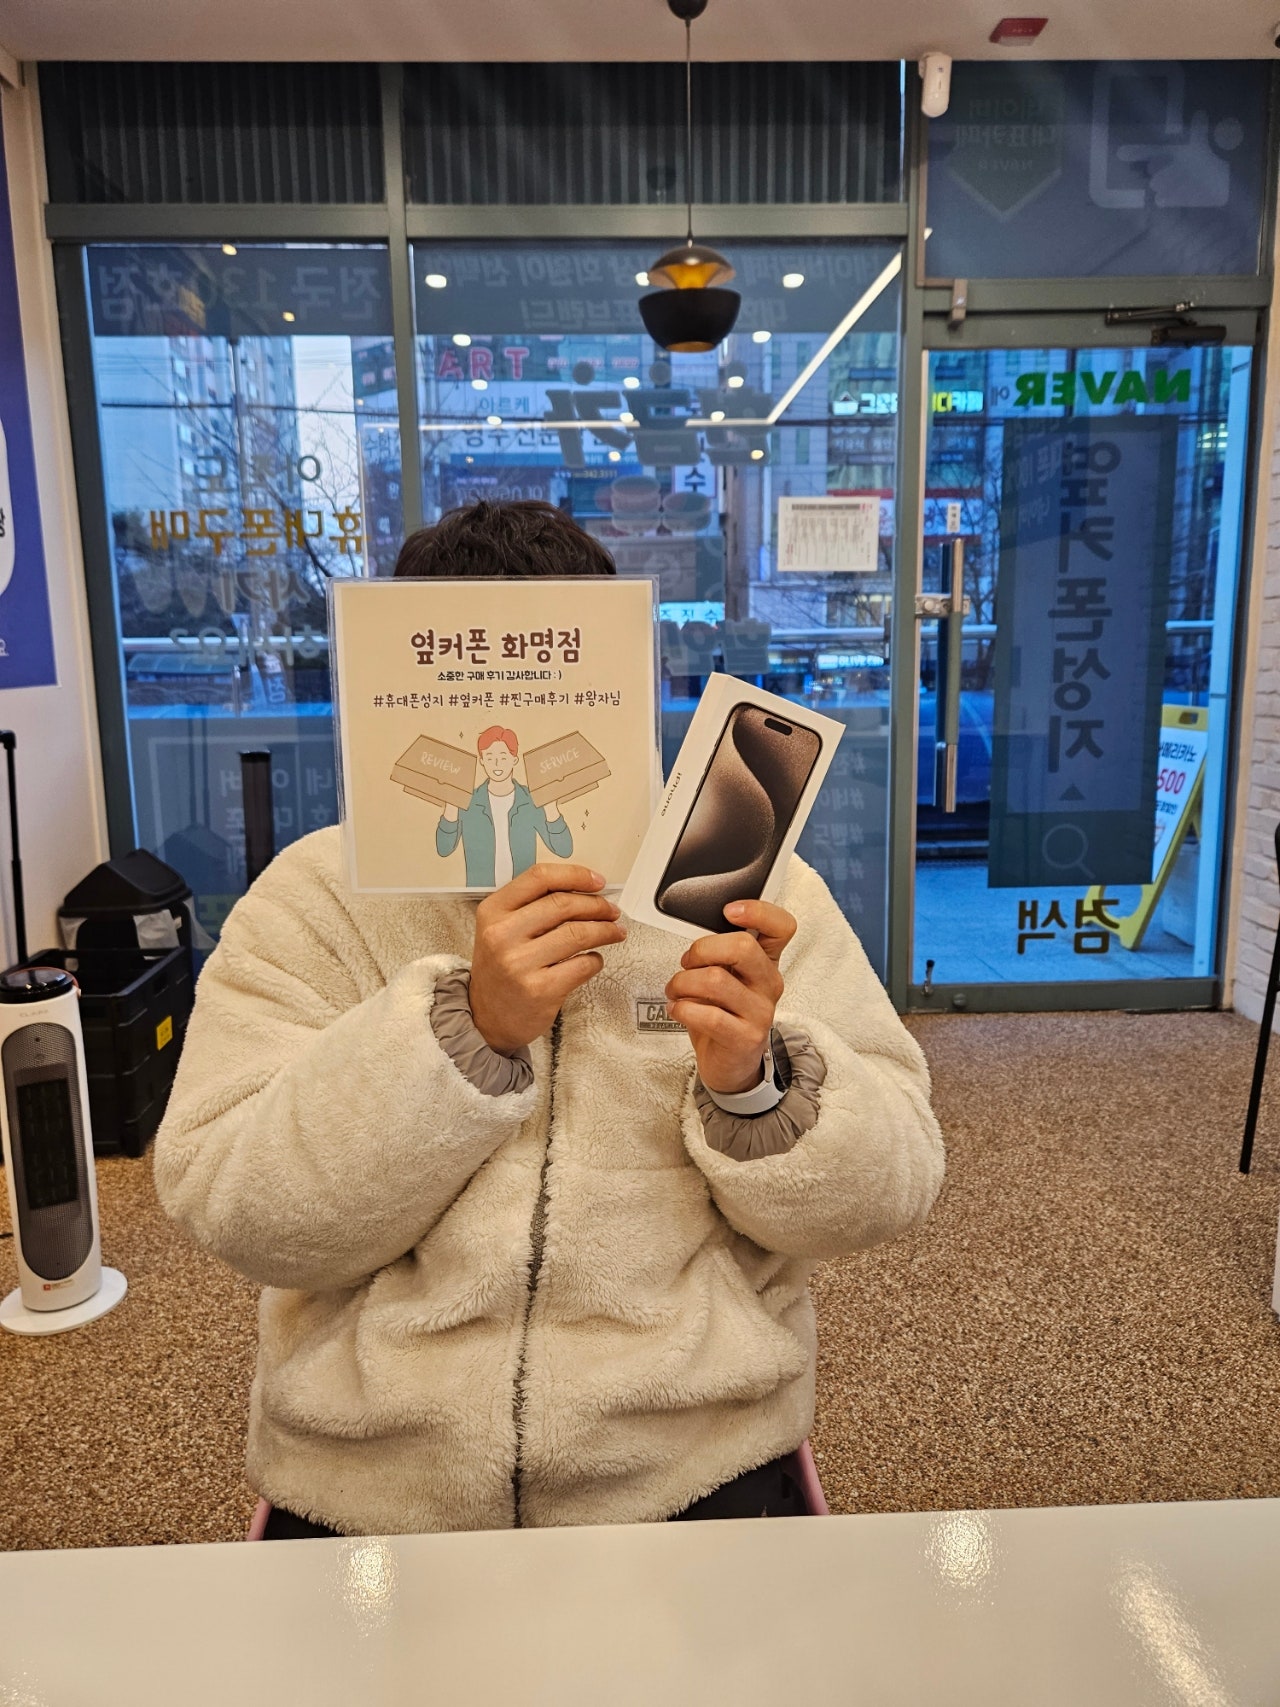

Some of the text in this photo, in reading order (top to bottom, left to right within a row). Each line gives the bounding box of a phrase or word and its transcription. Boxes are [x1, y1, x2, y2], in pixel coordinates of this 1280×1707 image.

[437, 346, 531, 381] ART
[411, 627, 582, 664] 옆커폰 화명점
[437, 670, 465, 682] 소중한
[467, 670, 485, 682] 구매
[486, 669, 505, 681] 후기
[506, 670, 551, 681] 감사합니다
[373, 690, 621, 709] #휴대폰성지 #옆커폰 #찐구매후기 #왕자님
[420, 751, 462, 775] REVIEW
[539, 748, 580, 774] SERVICE
[660, 771, 683, 818] iPhone
